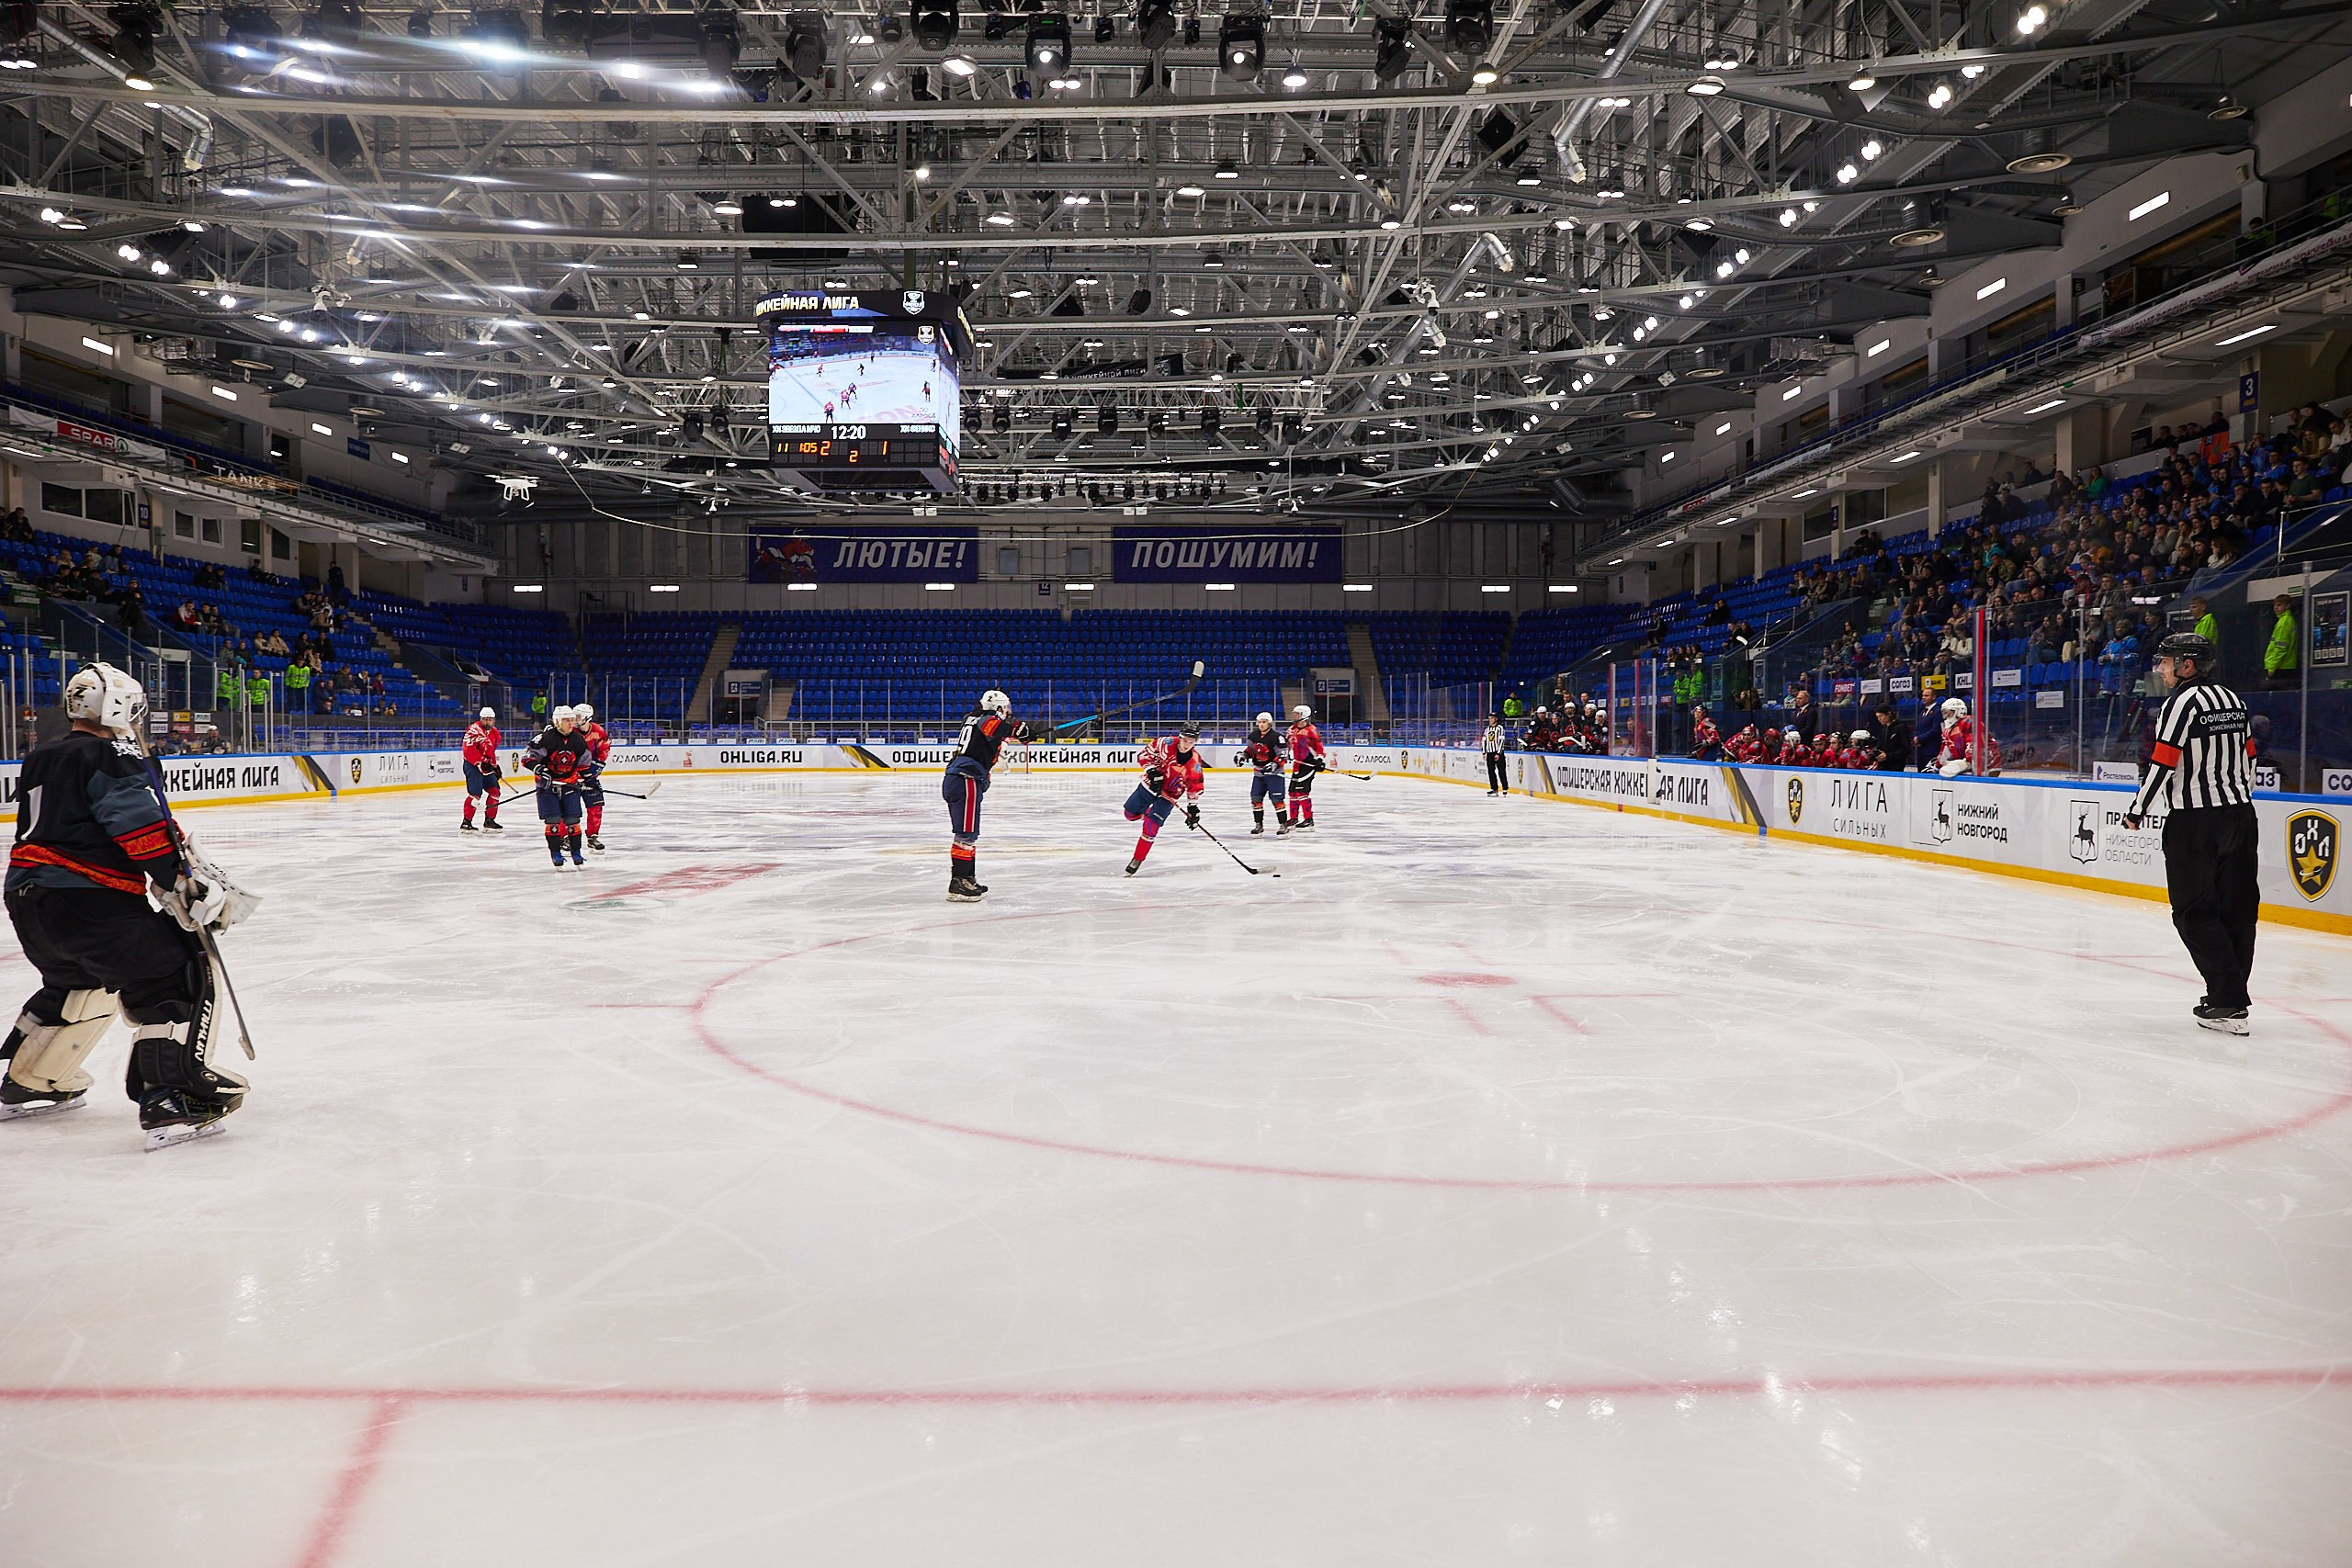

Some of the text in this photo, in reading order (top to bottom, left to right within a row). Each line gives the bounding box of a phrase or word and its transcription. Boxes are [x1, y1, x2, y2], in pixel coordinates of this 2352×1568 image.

[822, 296, 859, 310] ЛИГА
[2245, 378, 2254, 397] 3
[71, 427, 115, 448] SPAR
[831, 425, 866, 440] 12:20
[820, 441, 831, 456] 2
[849, 450, 858, 462] 2
[884, 441, 888, 456] 1
[140, 506, 149, 519] 10
[833, 541, 967, 569] ЛЮТЫЕ!
[1131, 541, 1318, 569] ПОШУМИМ!
[1956, 675, 1973, 686] KHL.
[379, 755, 410, 772] ЛИГА
[720, 750, 803, 763] OHLIGA.RU
[1008, 748, 1101, 763] ХОККЕЙНАЯ
[1107, 750, 1141, 763] ЛИГ
[243, 765, 279, 788] ЛИГА
[2103, 772, 2134, 781] Ростелеком
[1557, 766, 1611, 793] ОФИЦЕРСКАЯ
[1678, 776, 1708, 807] ЛИГА
[1831, 779, 1888, 814] ЛИГА
[20, 784, 43, 840] 1
[1957, 803, 1999, 820] НИЖНИЙ
[1833, 818, 1886, 839] СИЛЬНЫХ
[1957, 822, 2007, 844] НОВГОРОД
[2106, 833, 2163, 852] НИЖЕГОРО
[2105, 849, 2152, 866] ОБЛАСТИ
